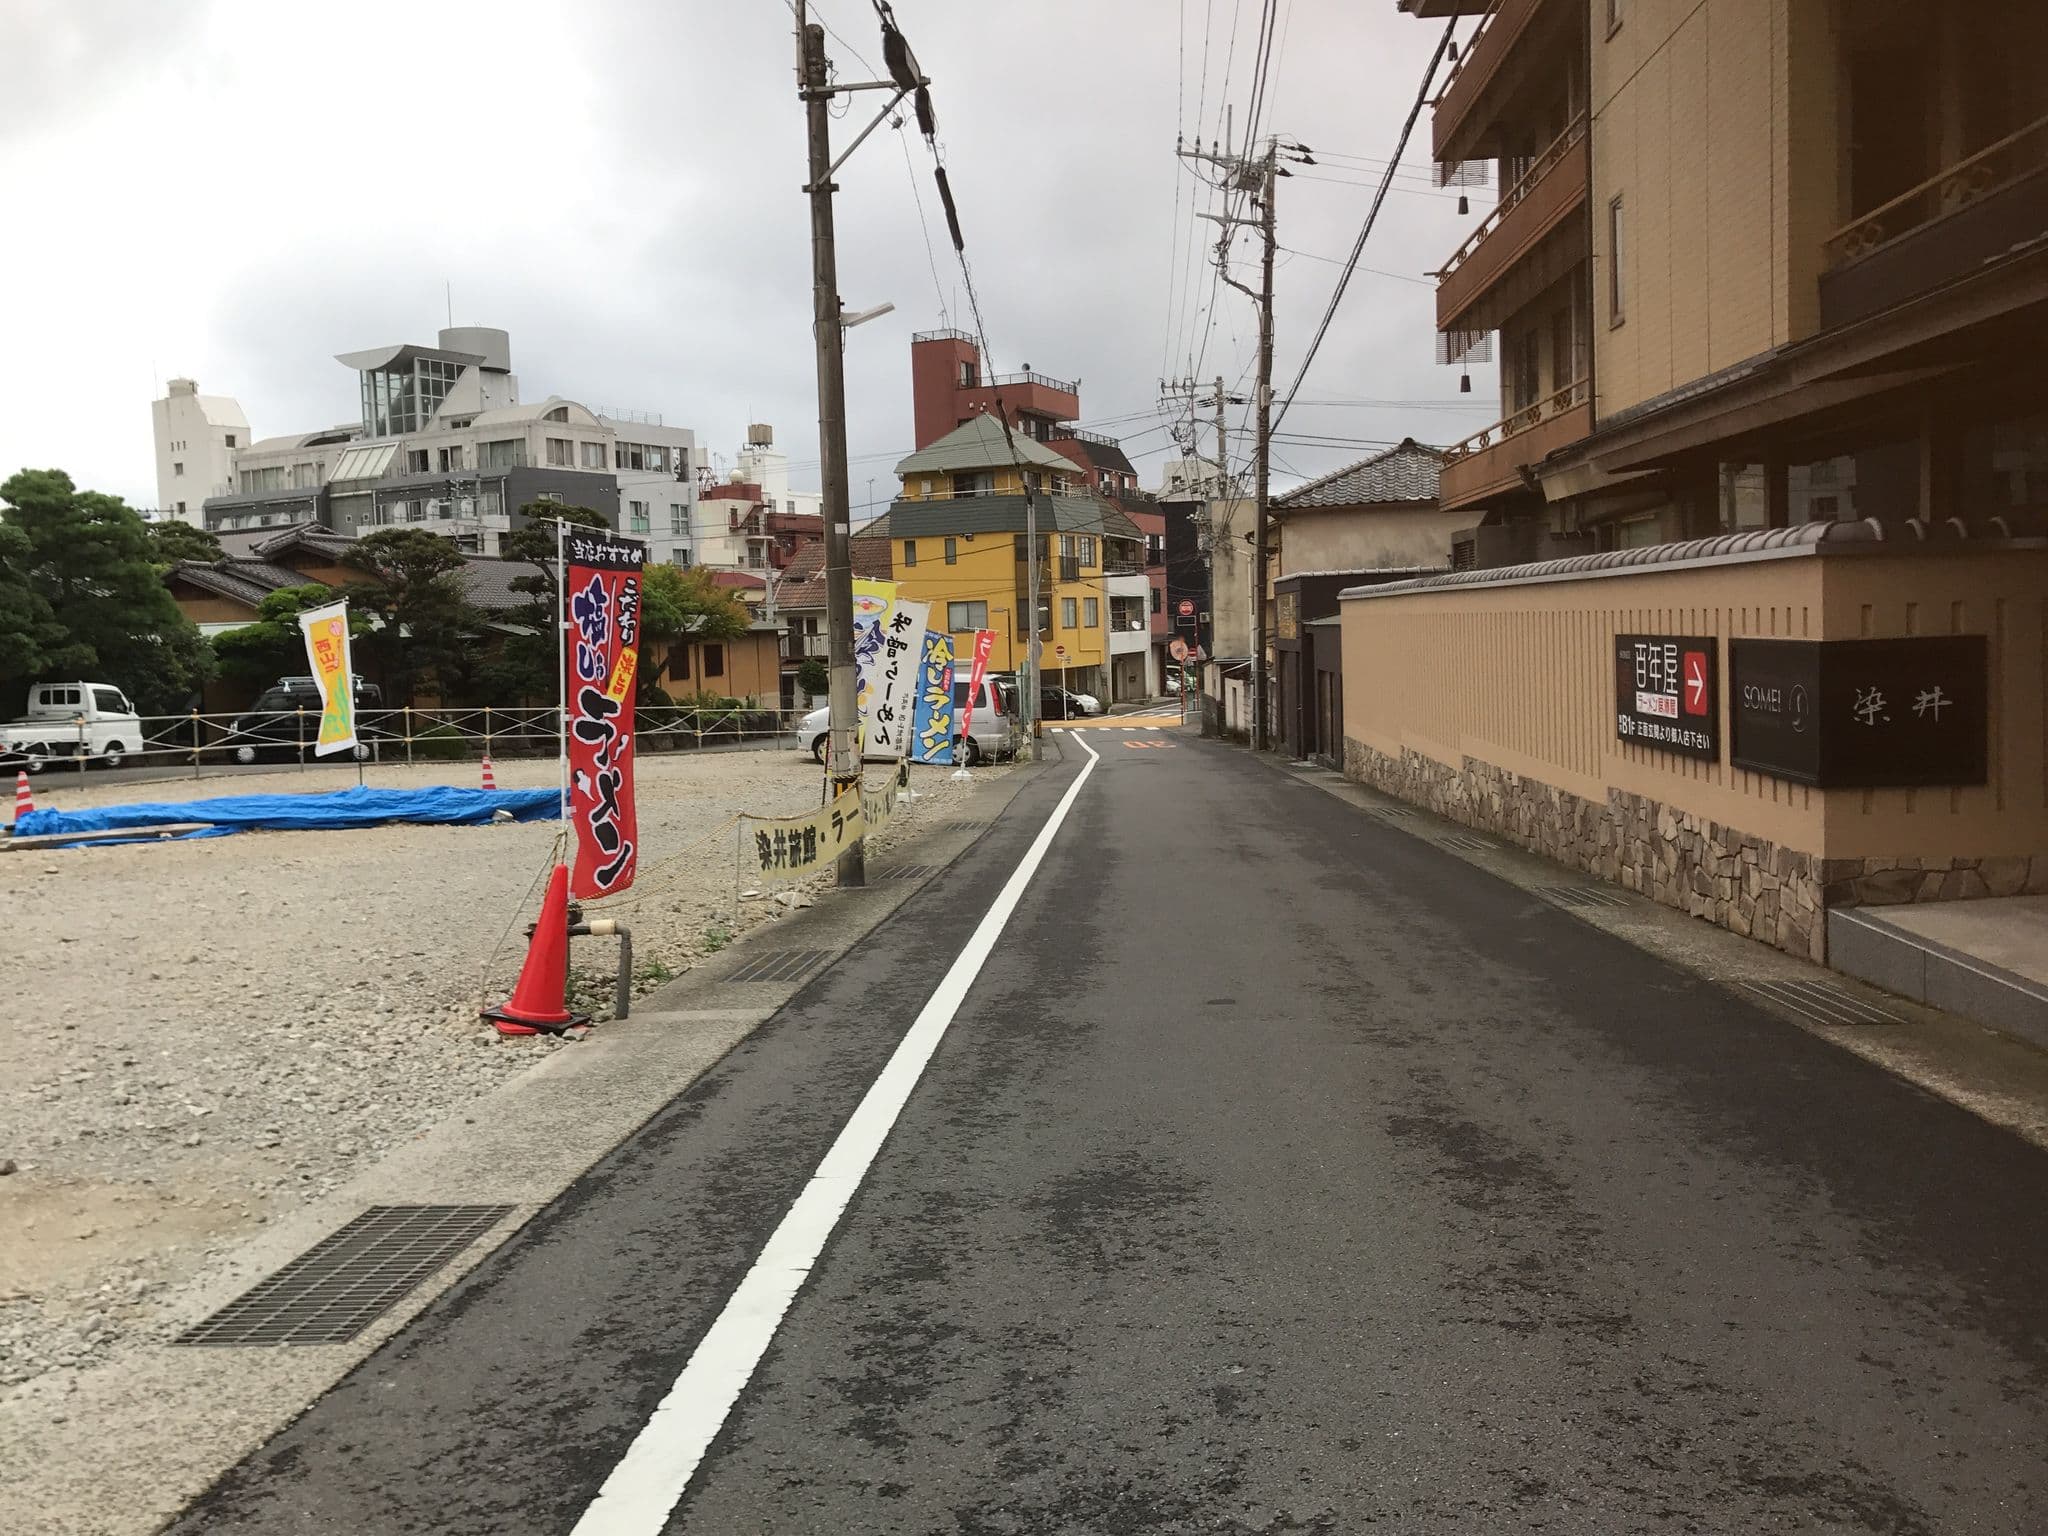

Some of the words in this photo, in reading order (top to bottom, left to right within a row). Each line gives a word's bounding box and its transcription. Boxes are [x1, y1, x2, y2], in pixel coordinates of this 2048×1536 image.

[571, 539, 642, 564] 当店おすすめ
[617, 578, 640, 646] こだわり
[1635, 643, 1679, 695] 百年屋
[920, 637, 954, 761] 冷しラーメン
[1743, 684, 1782, 713] SOMEI
[1850, 685, 1953, 726] 染井
[1637, 721, 1710, 750] 正面玄関より御入店下さい
[755, 808, 859, 872] 染井旅館・ラー
